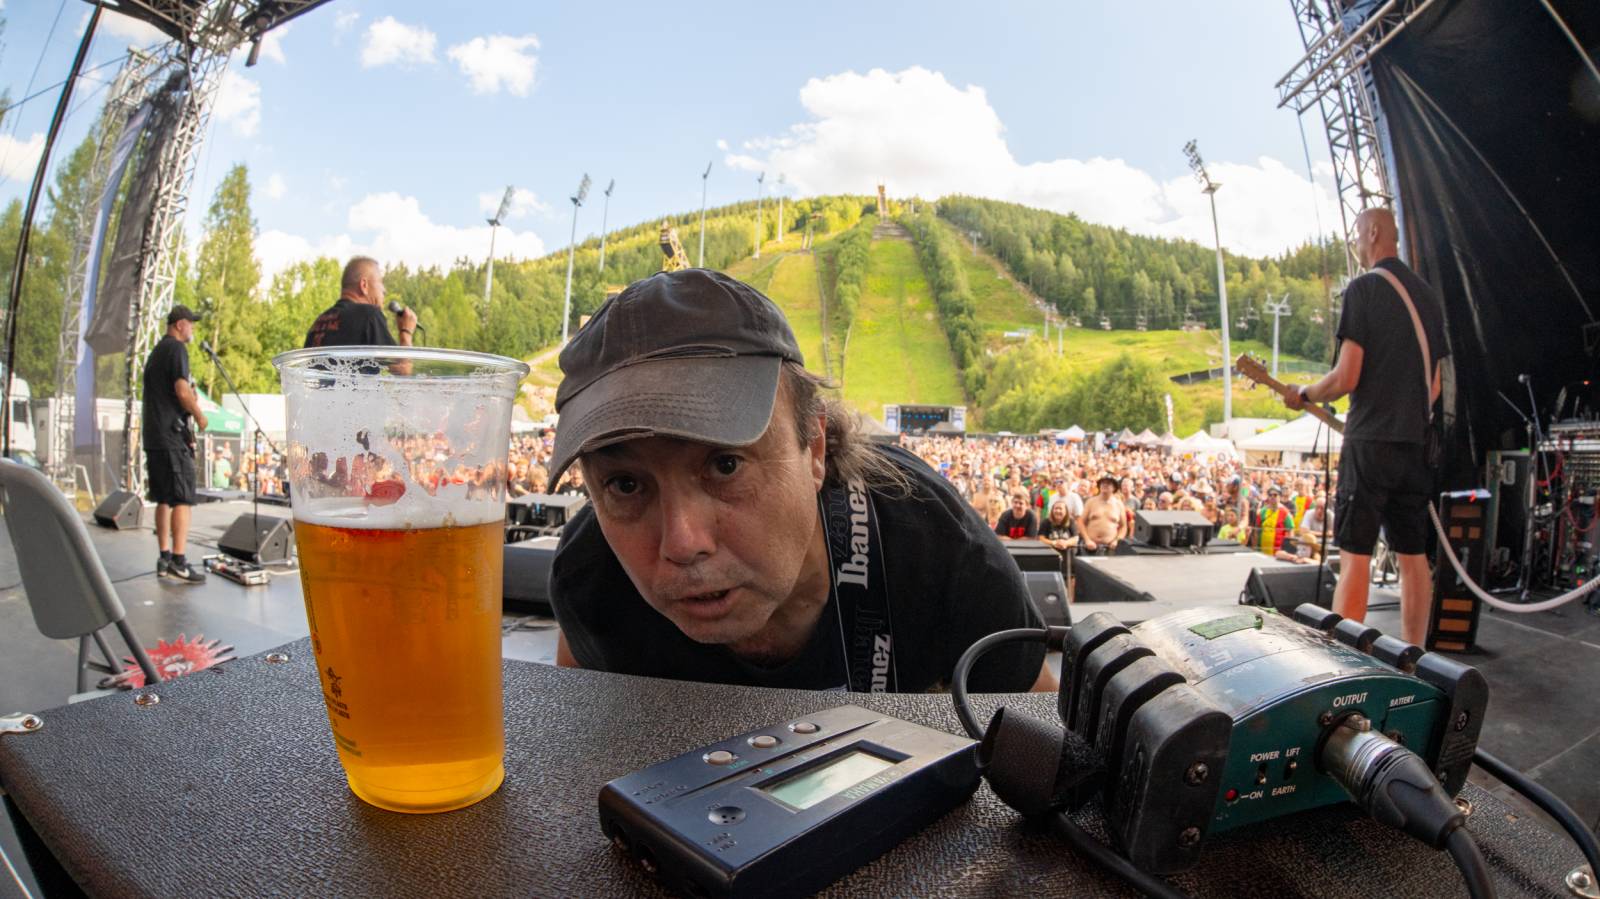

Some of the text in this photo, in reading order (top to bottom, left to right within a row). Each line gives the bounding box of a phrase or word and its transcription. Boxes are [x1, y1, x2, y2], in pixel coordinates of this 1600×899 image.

[837, 477, 869, 590] Ibanez
[870, 634, 891, 694] anez
[1332, 692, 1368, 708] OUTPUT
[1389, 695, 1416, 707] BATTERY
[1250, 751, 1280, 762] POWER
[1286, 747, 1301, 757] LIFT
[842, 775, 890, 800] YAMAHA
[1271, 785, 1296, 796] EARTH
[1249, 791, 1264, 799] ON
